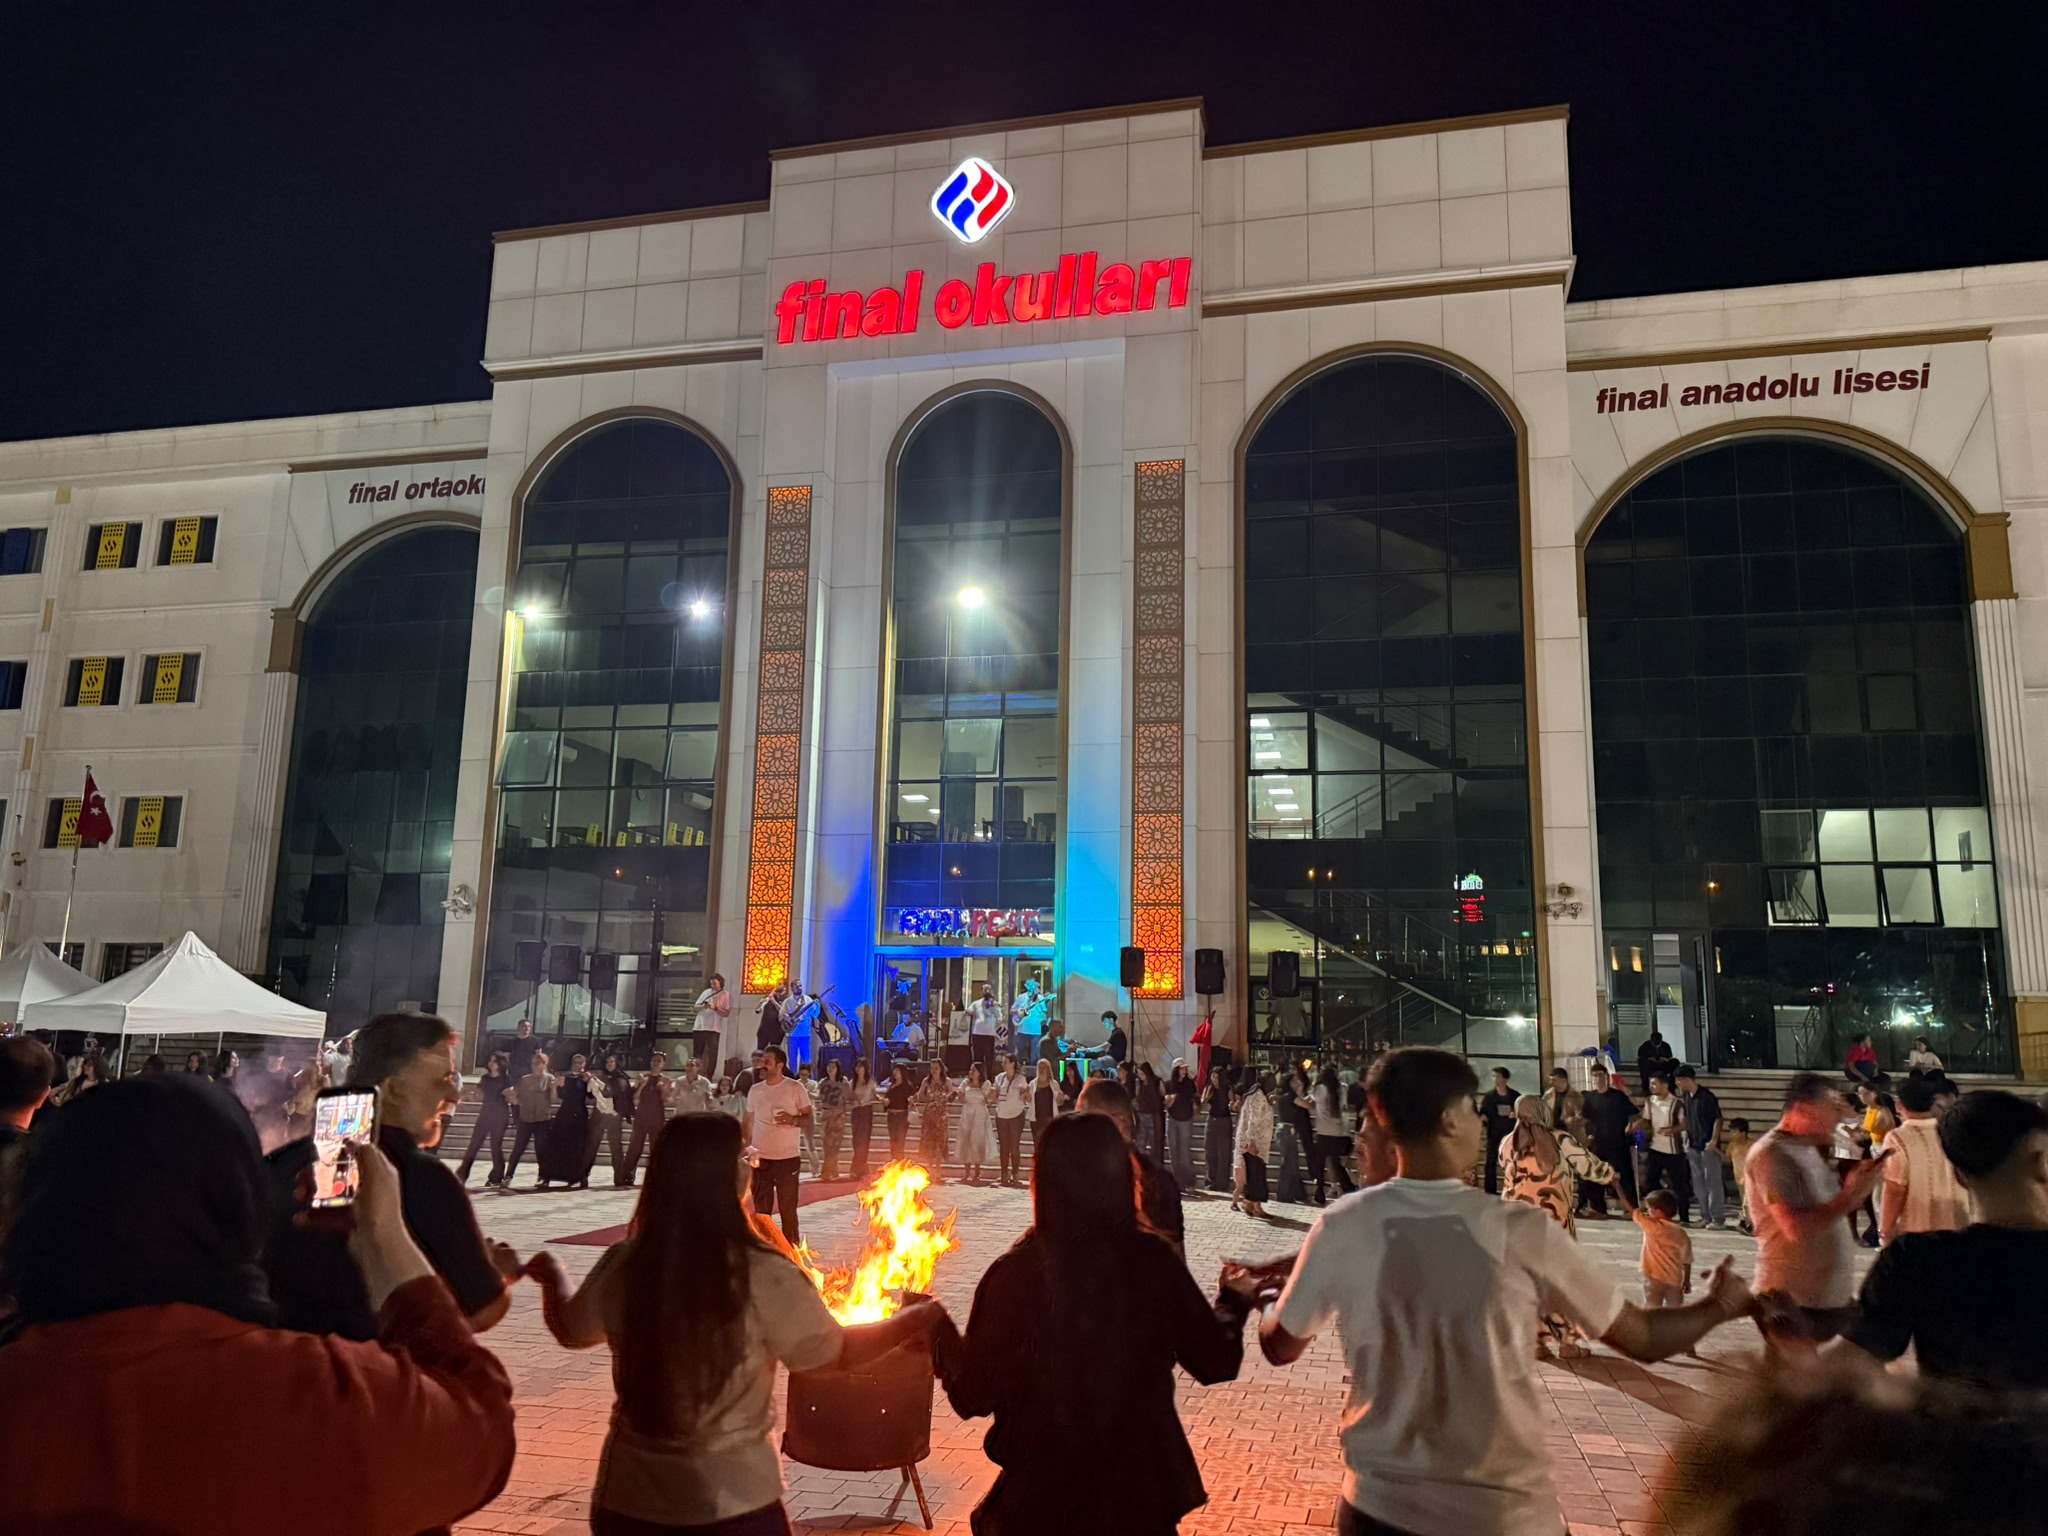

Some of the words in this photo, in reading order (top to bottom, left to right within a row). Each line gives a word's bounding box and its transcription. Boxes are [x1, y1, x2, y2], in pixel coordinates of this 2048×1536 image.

[776, 270, 923, 343] final
[935, 251, 1191, 329] okulları
[1596, 382, 1669, 414] final
[1680, 373, 1820, 407] anadolu
[1833, 362, 1931, 395] lisesi
[348, 480, 399, 504] final
[971, 908, 1040, 938] FEST
